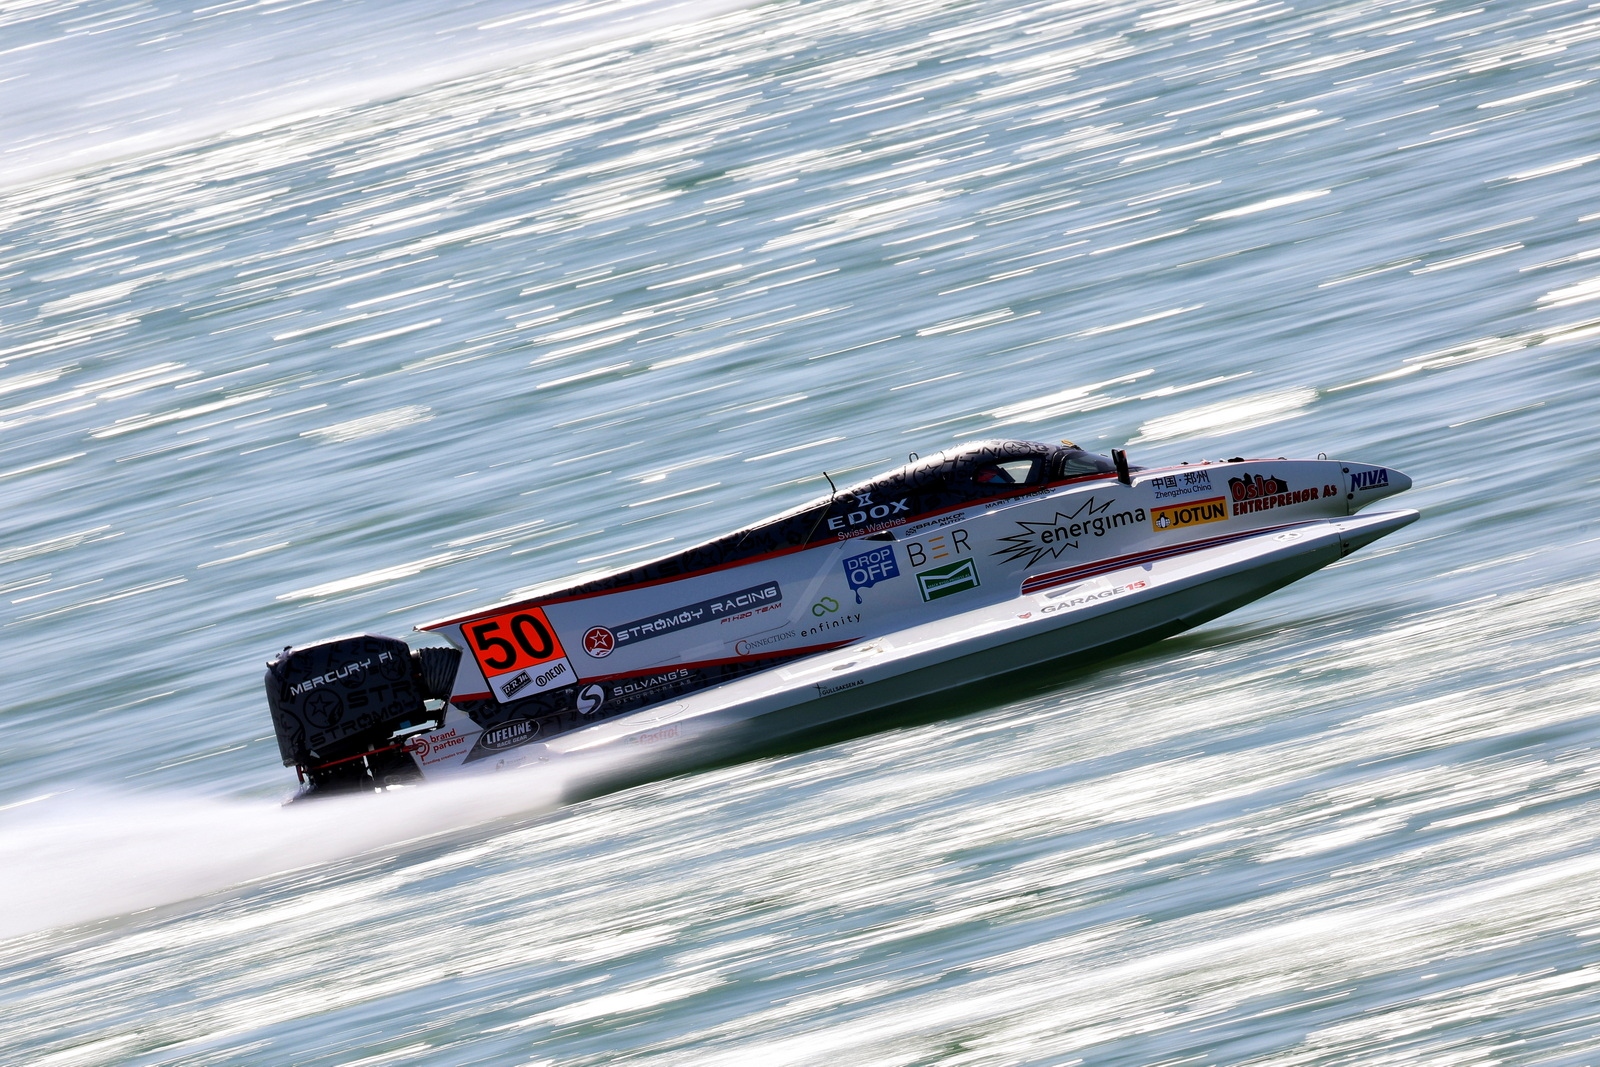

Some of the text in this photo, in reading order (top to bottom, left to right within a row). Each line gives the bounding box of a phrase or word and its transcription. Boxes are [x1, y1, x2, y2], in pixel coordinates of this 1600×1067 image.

[1155, 484, 1212, 499] Zhengzhou China
[1232, 476, 1278, 501] Oslo
[1350, 468, 1389, 492] NIVA
[1233, 487, 1319, 516] ENTREPRENØR
[1323, 484, 1338, 498] AS
[827, 498, 910, 531] EDOX
[1041, 507, 1147, 544] energima
[1173, 503, 1225, 526] JOTUN
[837, 517, 907, 541] Swiss Watches
[848, 549, 891, 570] DROP
[906, 529, 972, 567] BER
[851, 560, 894, 585] OFF
[711, 586, 778, 614] RACING
[755, 603, 782, 614] TEAM
[801, 613, 861, 637] enfinity
[472, 614, 554, 669] 50
[735, 630, 796, 656] CONNECTIONS
[290, 658, 371, 696] MERCURY
[613, 668, 689, 696] SOLVANG'S
[430, 728, 456, 743] brand
[433, 736, 465, 753] partner
[486, 721, 532, 745] LIFELINE
[640, 725, 680, 745] Castrol
